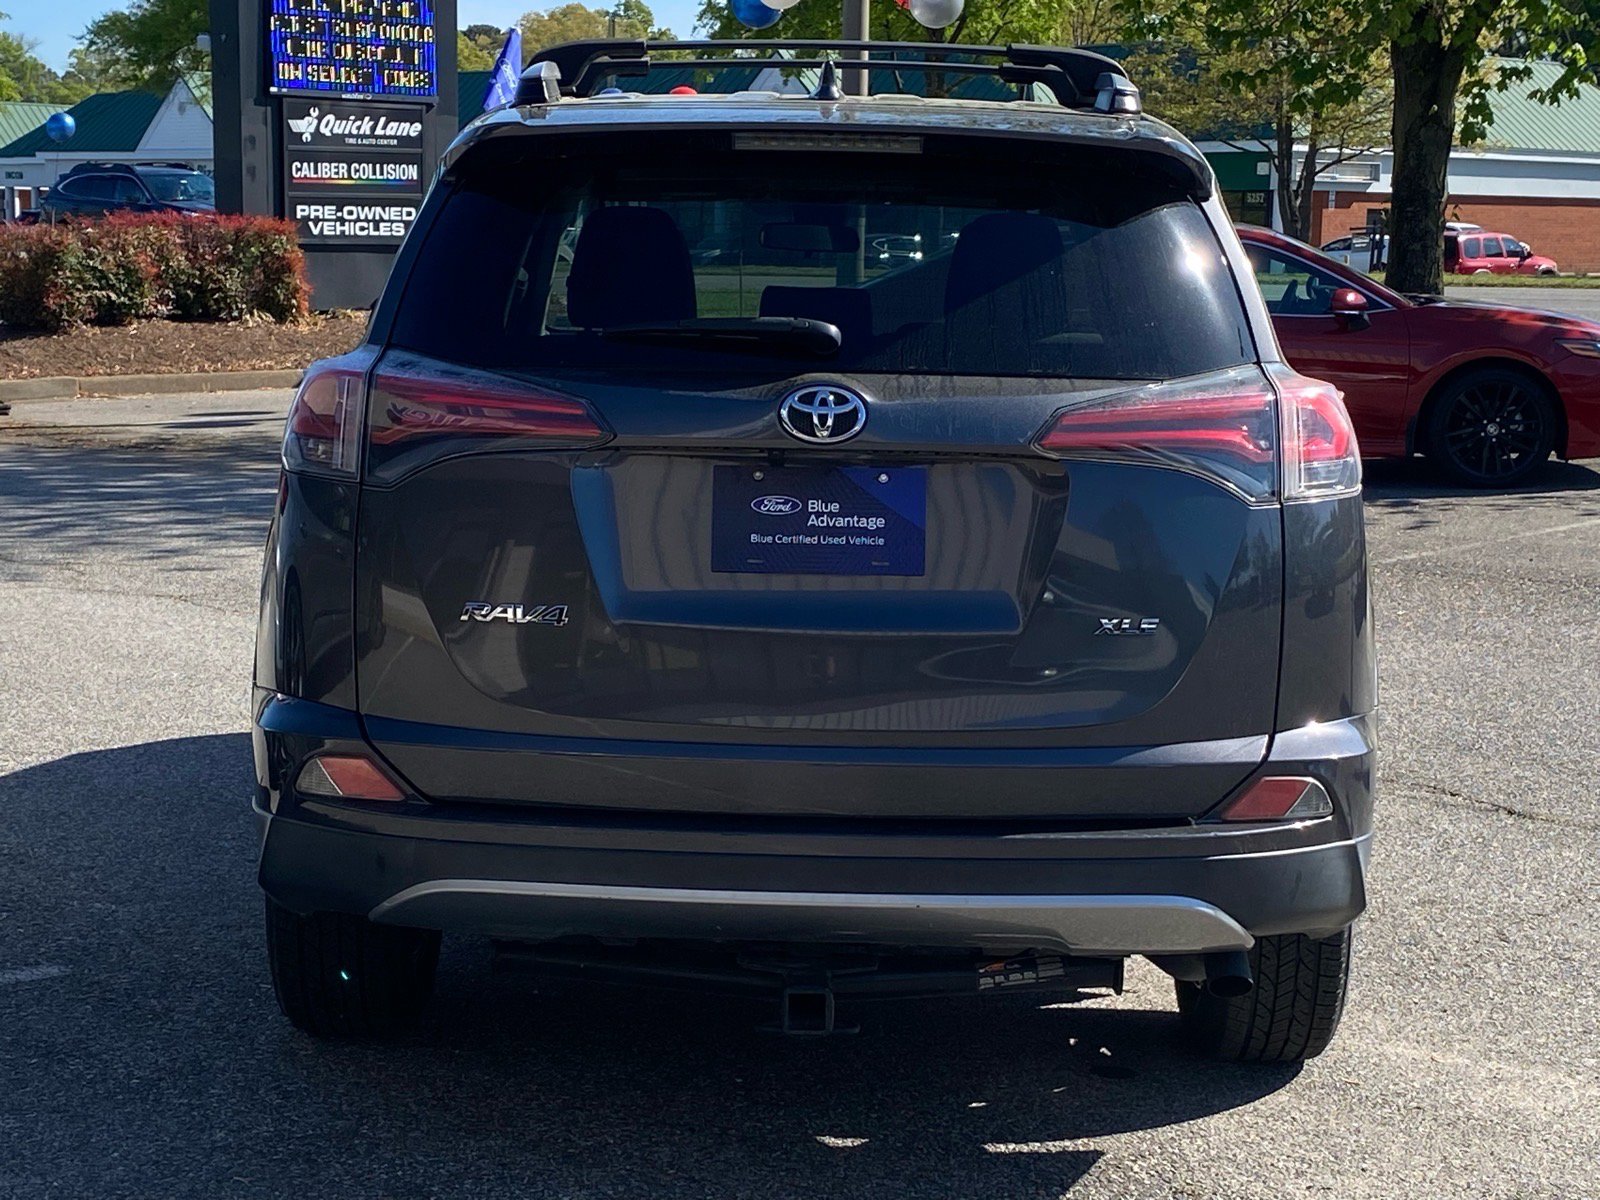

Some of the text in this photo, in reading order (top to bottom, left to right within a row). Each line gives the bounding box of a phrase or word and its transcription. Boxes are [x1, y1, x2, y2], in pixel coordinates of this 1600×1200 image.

[319, 114, 422, 137] Quick Lane
[292, 162, 418, 180] CALIBER COLLISION
[296, 205, 417, 220] PRE-OWNED
[308, 221, 405, 236] VEHICLES
[808, 500, 840, 513] Blue
[807, 514, 885, 530] Advantage
[751, 533, 885, 545] Blue Certified Used Vehicle
[460, 602, 569, 626] RAV4
[1093, 618, 1160, 635] XLE
